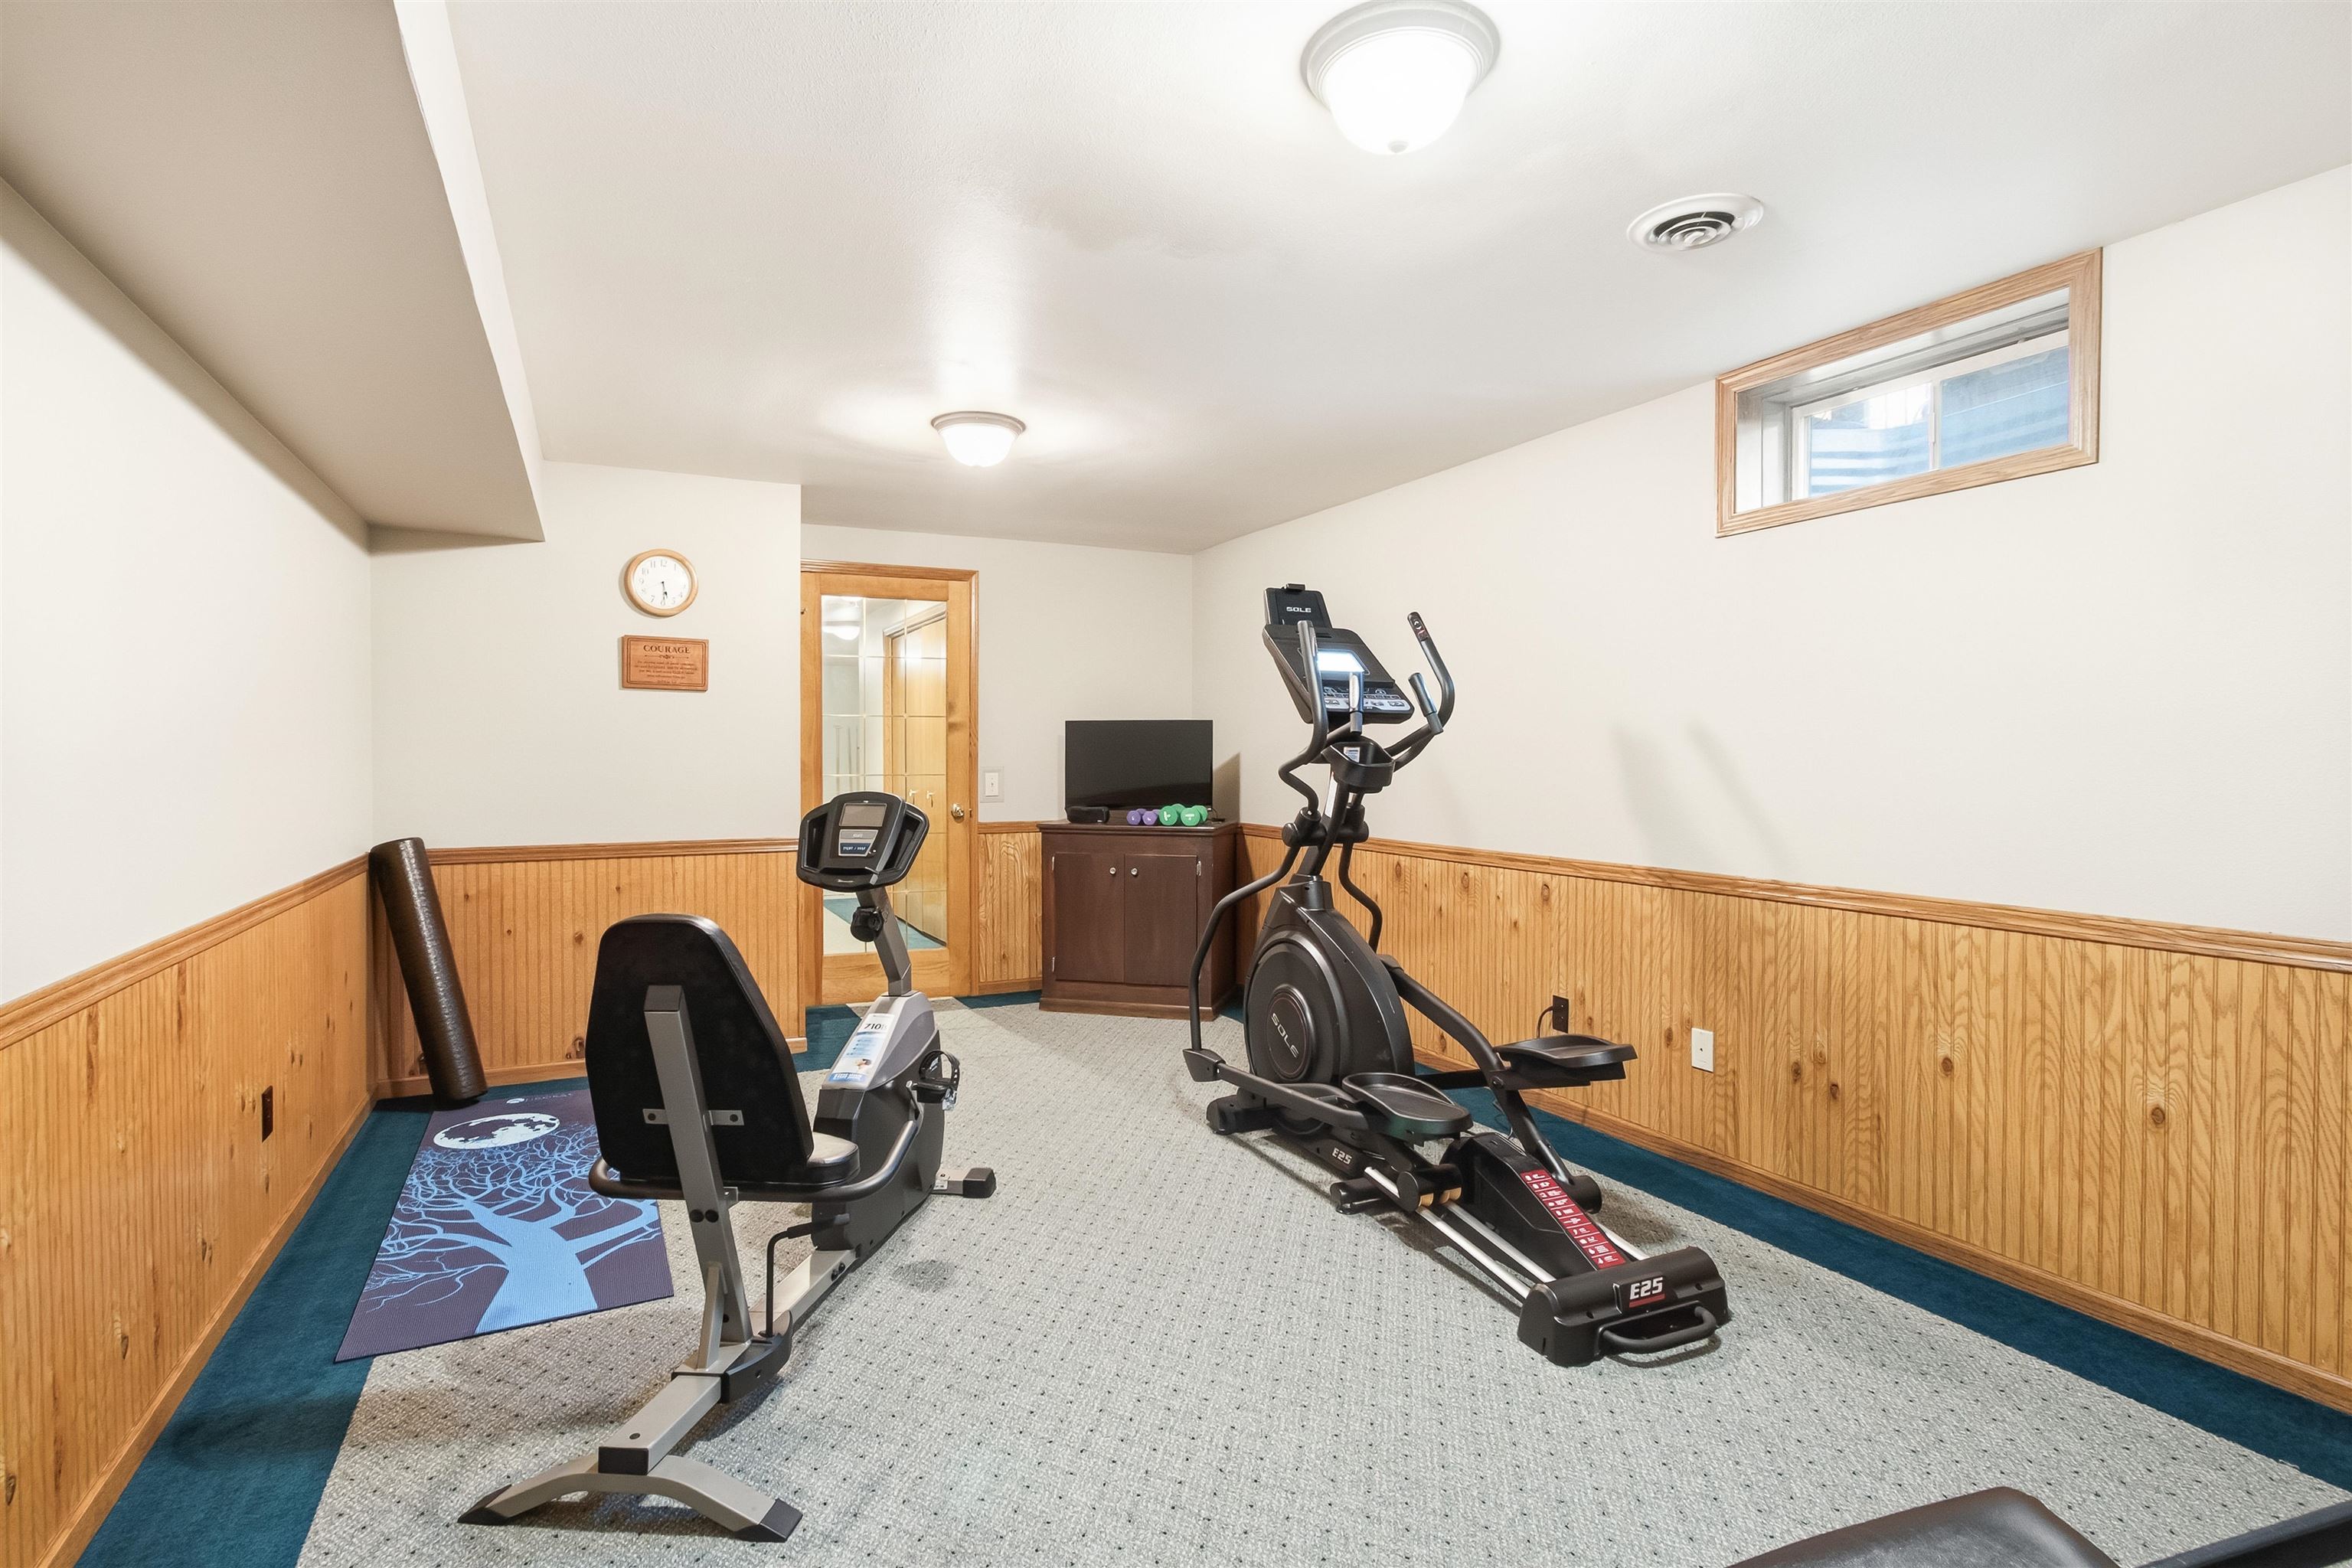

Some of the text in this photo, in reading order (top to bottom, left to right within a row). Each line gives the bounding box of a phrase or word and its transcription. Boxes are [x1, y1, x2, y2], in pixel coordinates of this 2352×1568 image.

[643, 645, 691, 654] COURAGE
[1271, 1012, 1299, 1058] SOLE
[1331, 1148, 1353, 1165] E25
[1629, 1277, 1664, 1300] E25
